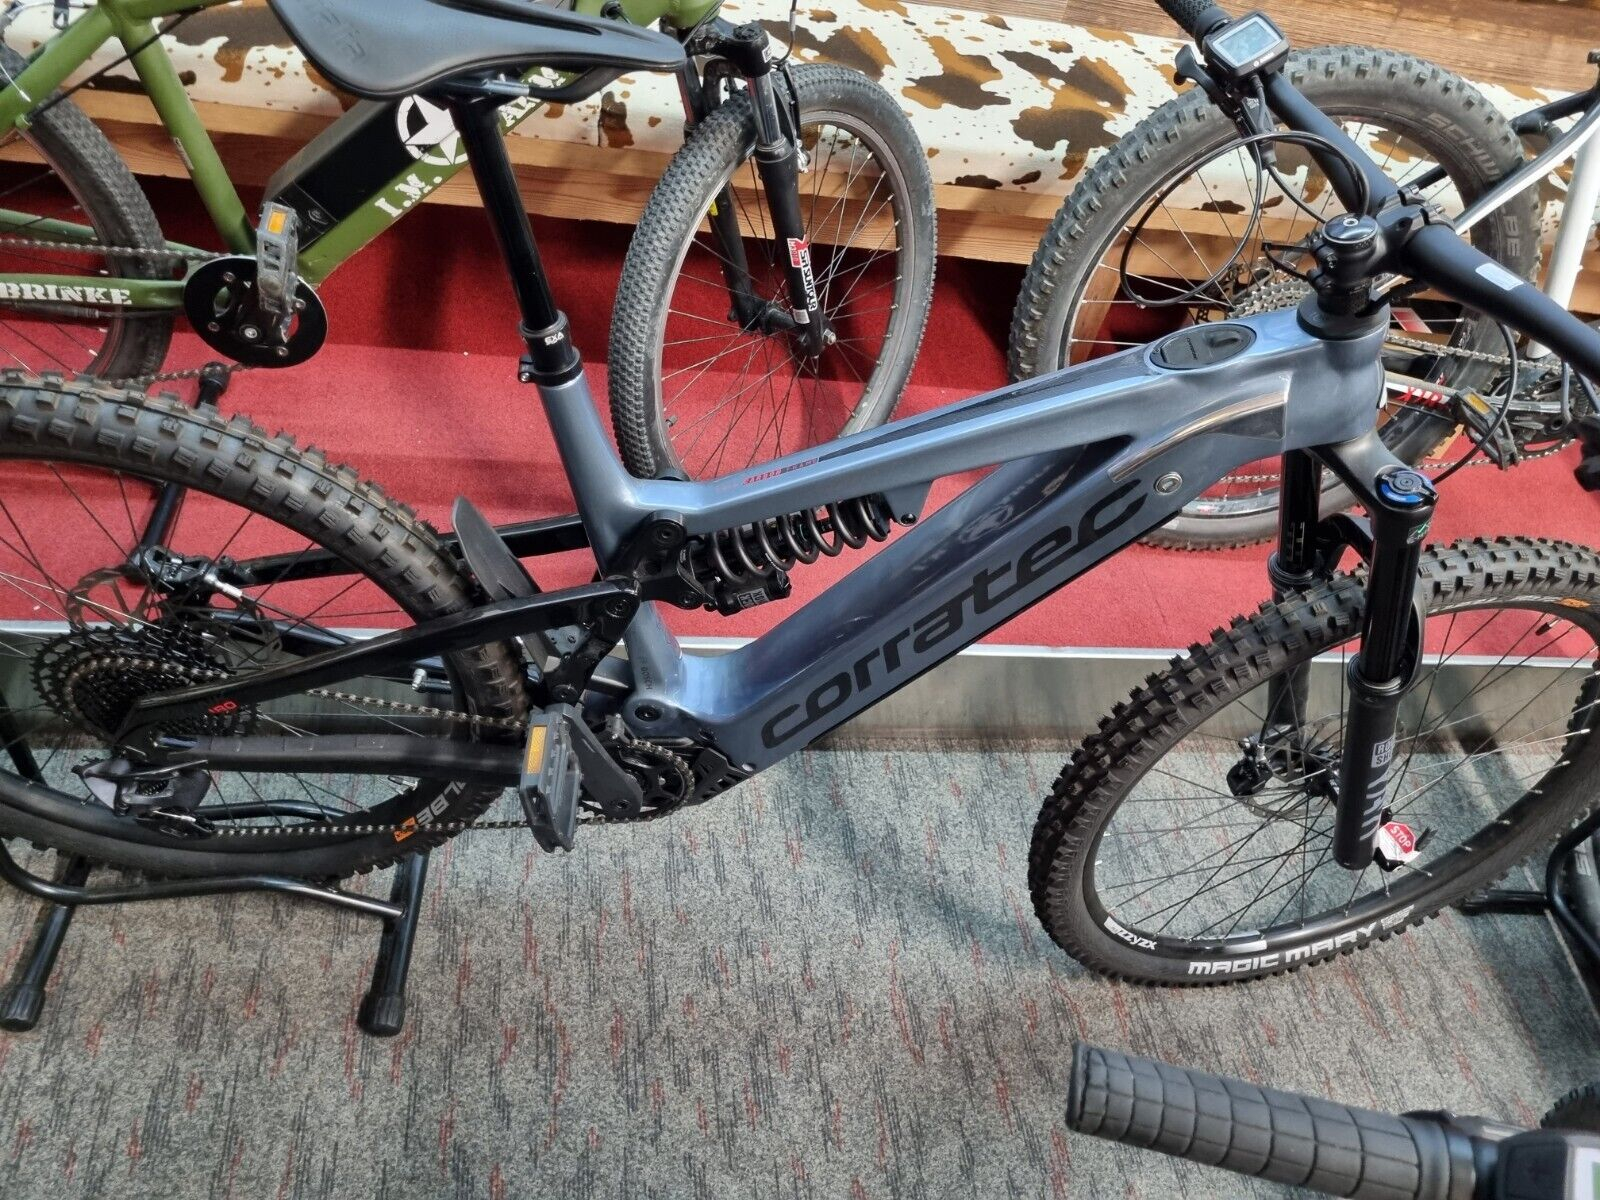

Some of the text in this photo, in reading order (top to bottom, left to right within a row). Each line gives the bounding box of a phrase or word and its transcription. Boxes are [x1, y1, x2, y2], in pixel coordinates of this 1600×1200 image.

[0, 282, 132, 305] BRINKE
[761, 479, 1148, 749] corratec
[1390, 825, 1412, 848] STOP
[1187, 921, 1378, 975] MAGIC MARY
